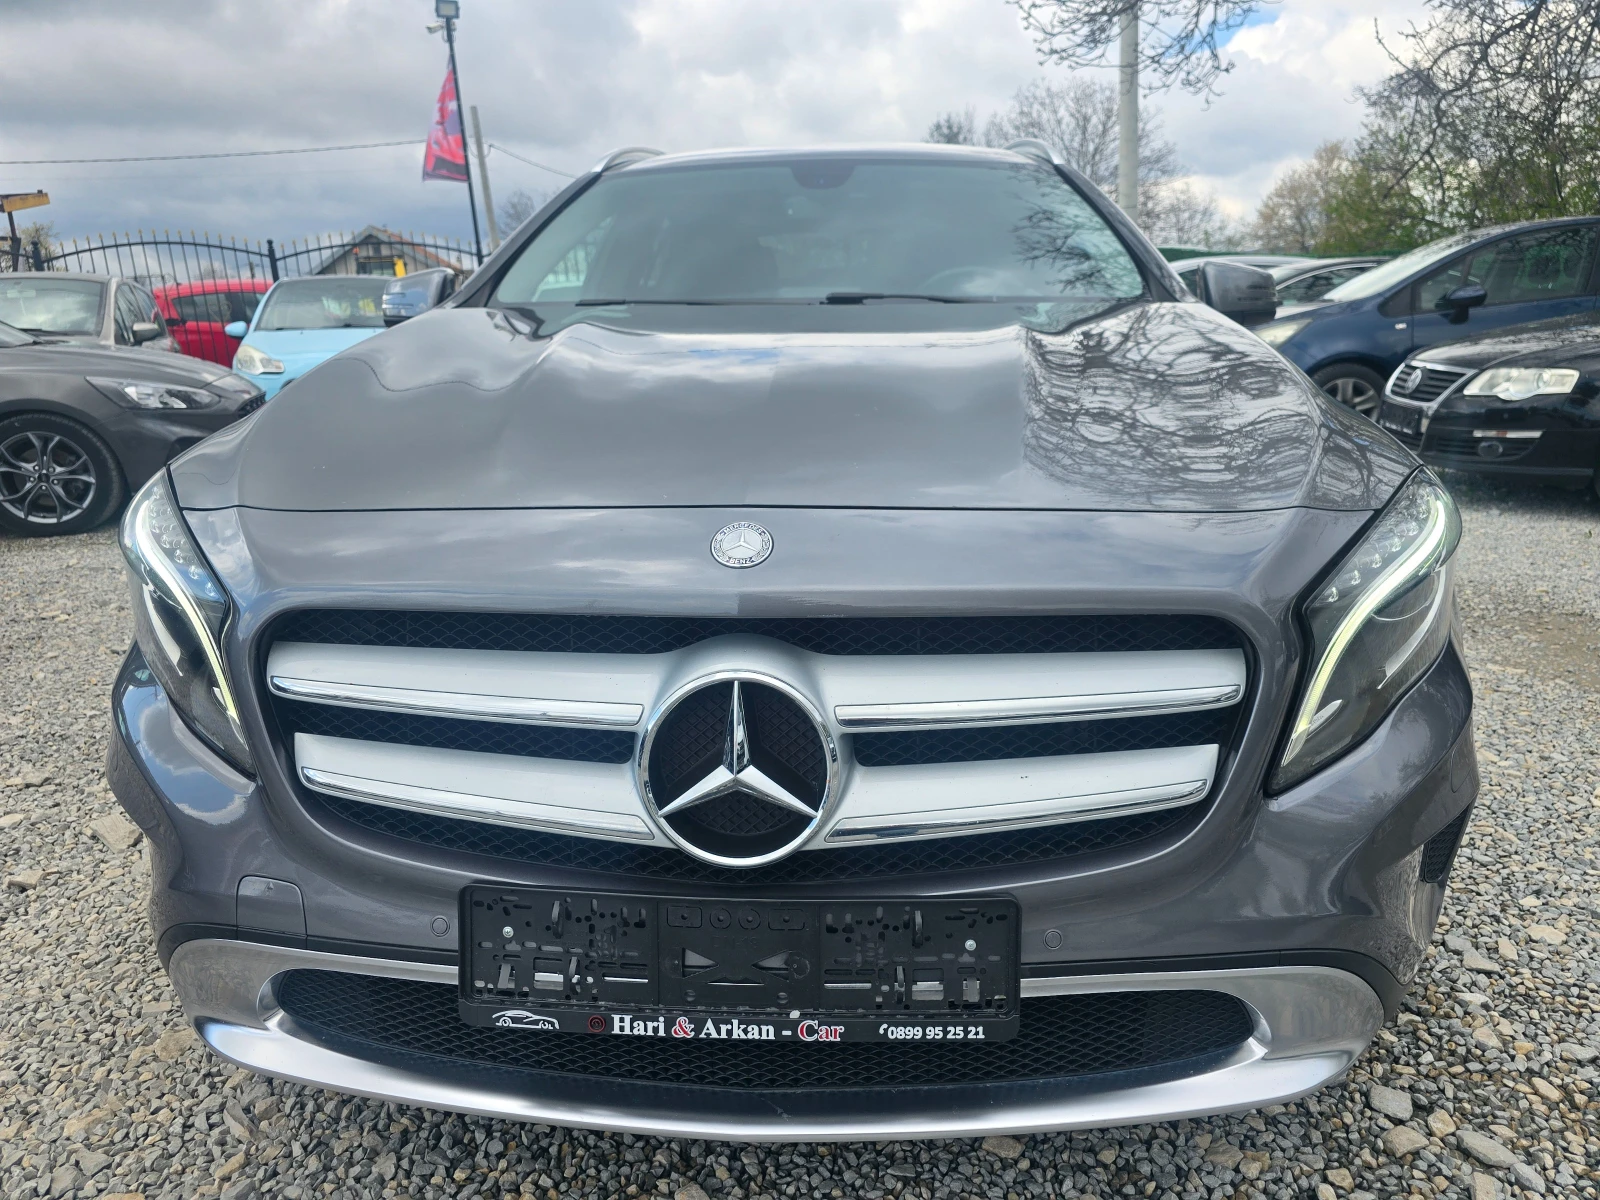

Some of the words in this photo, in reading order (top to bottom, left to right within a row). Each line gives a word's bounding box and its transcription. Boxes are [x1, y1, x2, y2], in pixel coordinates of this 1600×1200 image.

[729, 557, 752, 565] BENZ
[611, 1014, 666, 1036] Hari
[671, 1016, 695, 1039] &
[698, 1017, 775, 1040] Arkan
[797, 1019, 845, 1042] Car
[887, 1026, 923, 1040] 0899
[925, 1026, 944, 1040] 95
[946, 1026, 965, 1040] 25
[967, 1026, 985, 1040] 21
